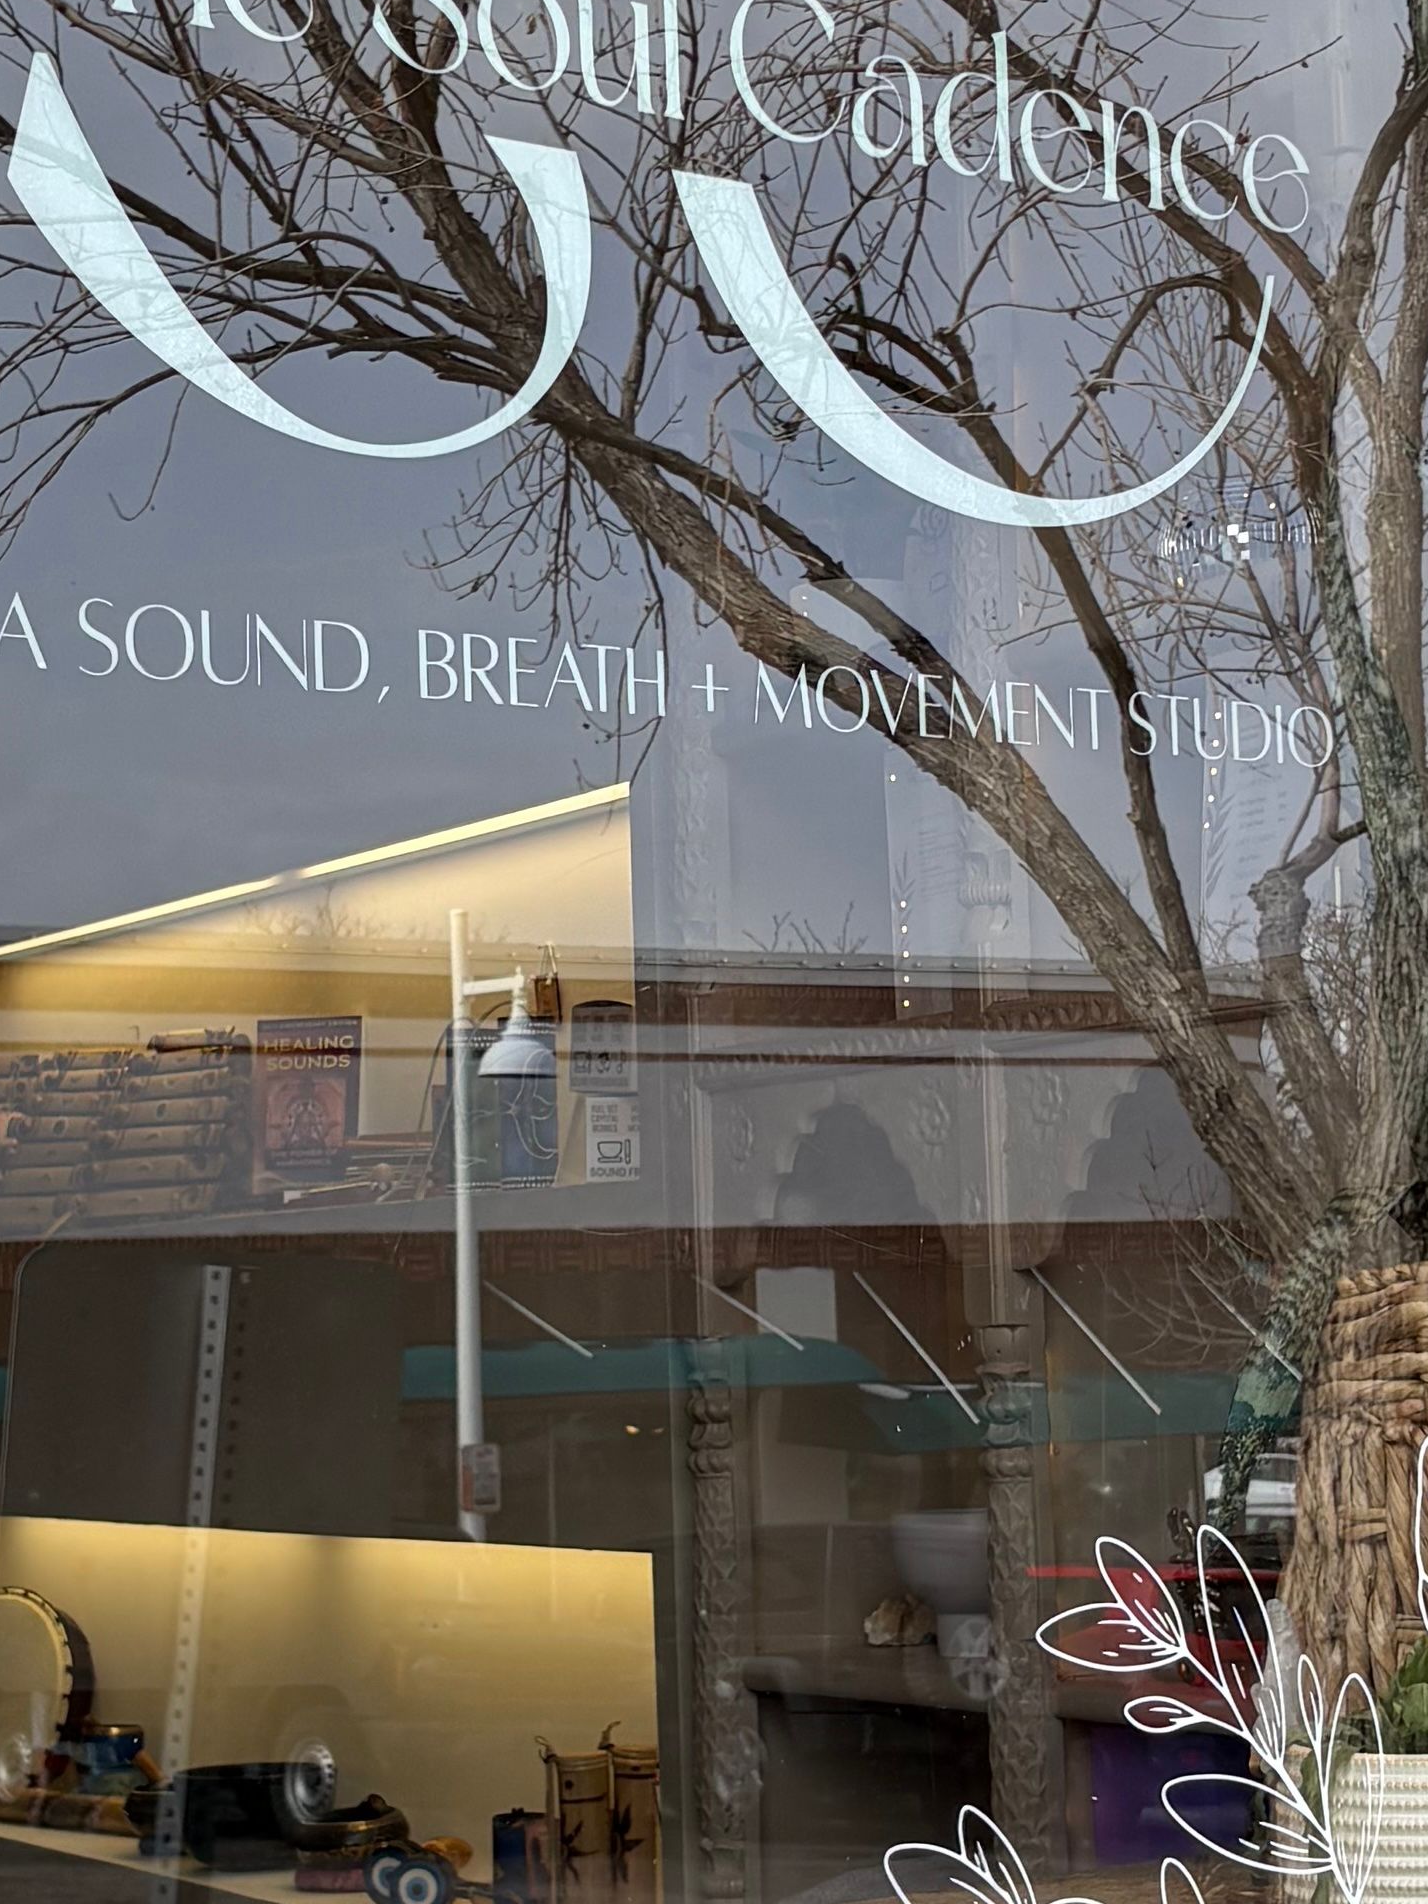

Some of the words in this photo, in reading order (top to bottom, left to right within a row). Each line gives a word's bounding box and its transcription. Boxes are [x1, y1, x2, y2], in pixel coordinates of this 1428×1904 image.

[77, 598, 390, 704] SOUND,
[417, 628, 668, 716] BREATH
[691, 662, 731, 712] +
[754, 662, 1108, 752] MOVEMENT
[1128, 690, 1334, 768] STUDIO
[264, 1035, 355, 1053] HEALING
[267, 1054, 352, 1072] SOUNDS
[590, 1166, 625, 1178] SOUND
